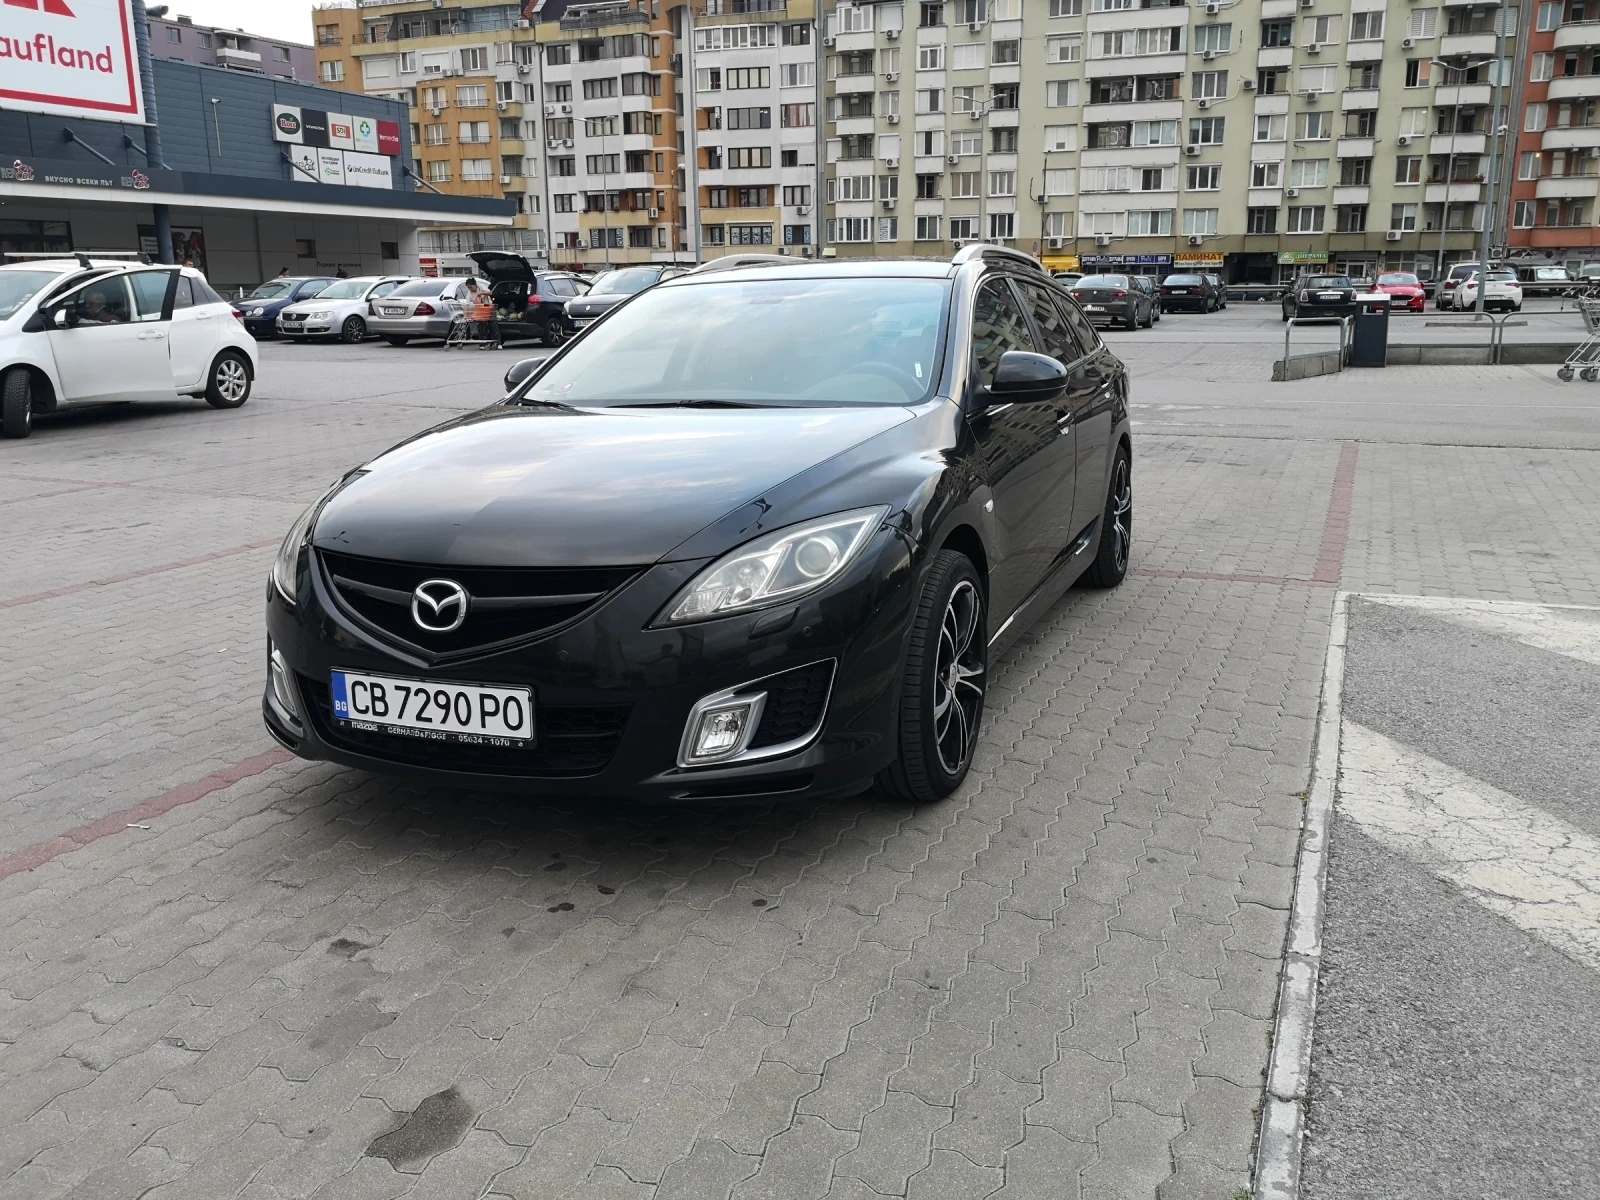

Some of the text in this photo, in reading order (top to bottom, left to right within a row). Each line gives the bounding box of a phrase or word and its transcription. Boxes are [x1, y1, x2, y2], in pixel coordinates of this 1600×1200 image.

[353, 165, 390, 176] UniCredit Bulbank
[44, 175, 113, 187] ВКУСНО ВСЕКИ ПЪТ
[1174, 253, 1224, 261] ЛАМИНАТ
[335, 680, 524, 731] BG CB 7290 PO
